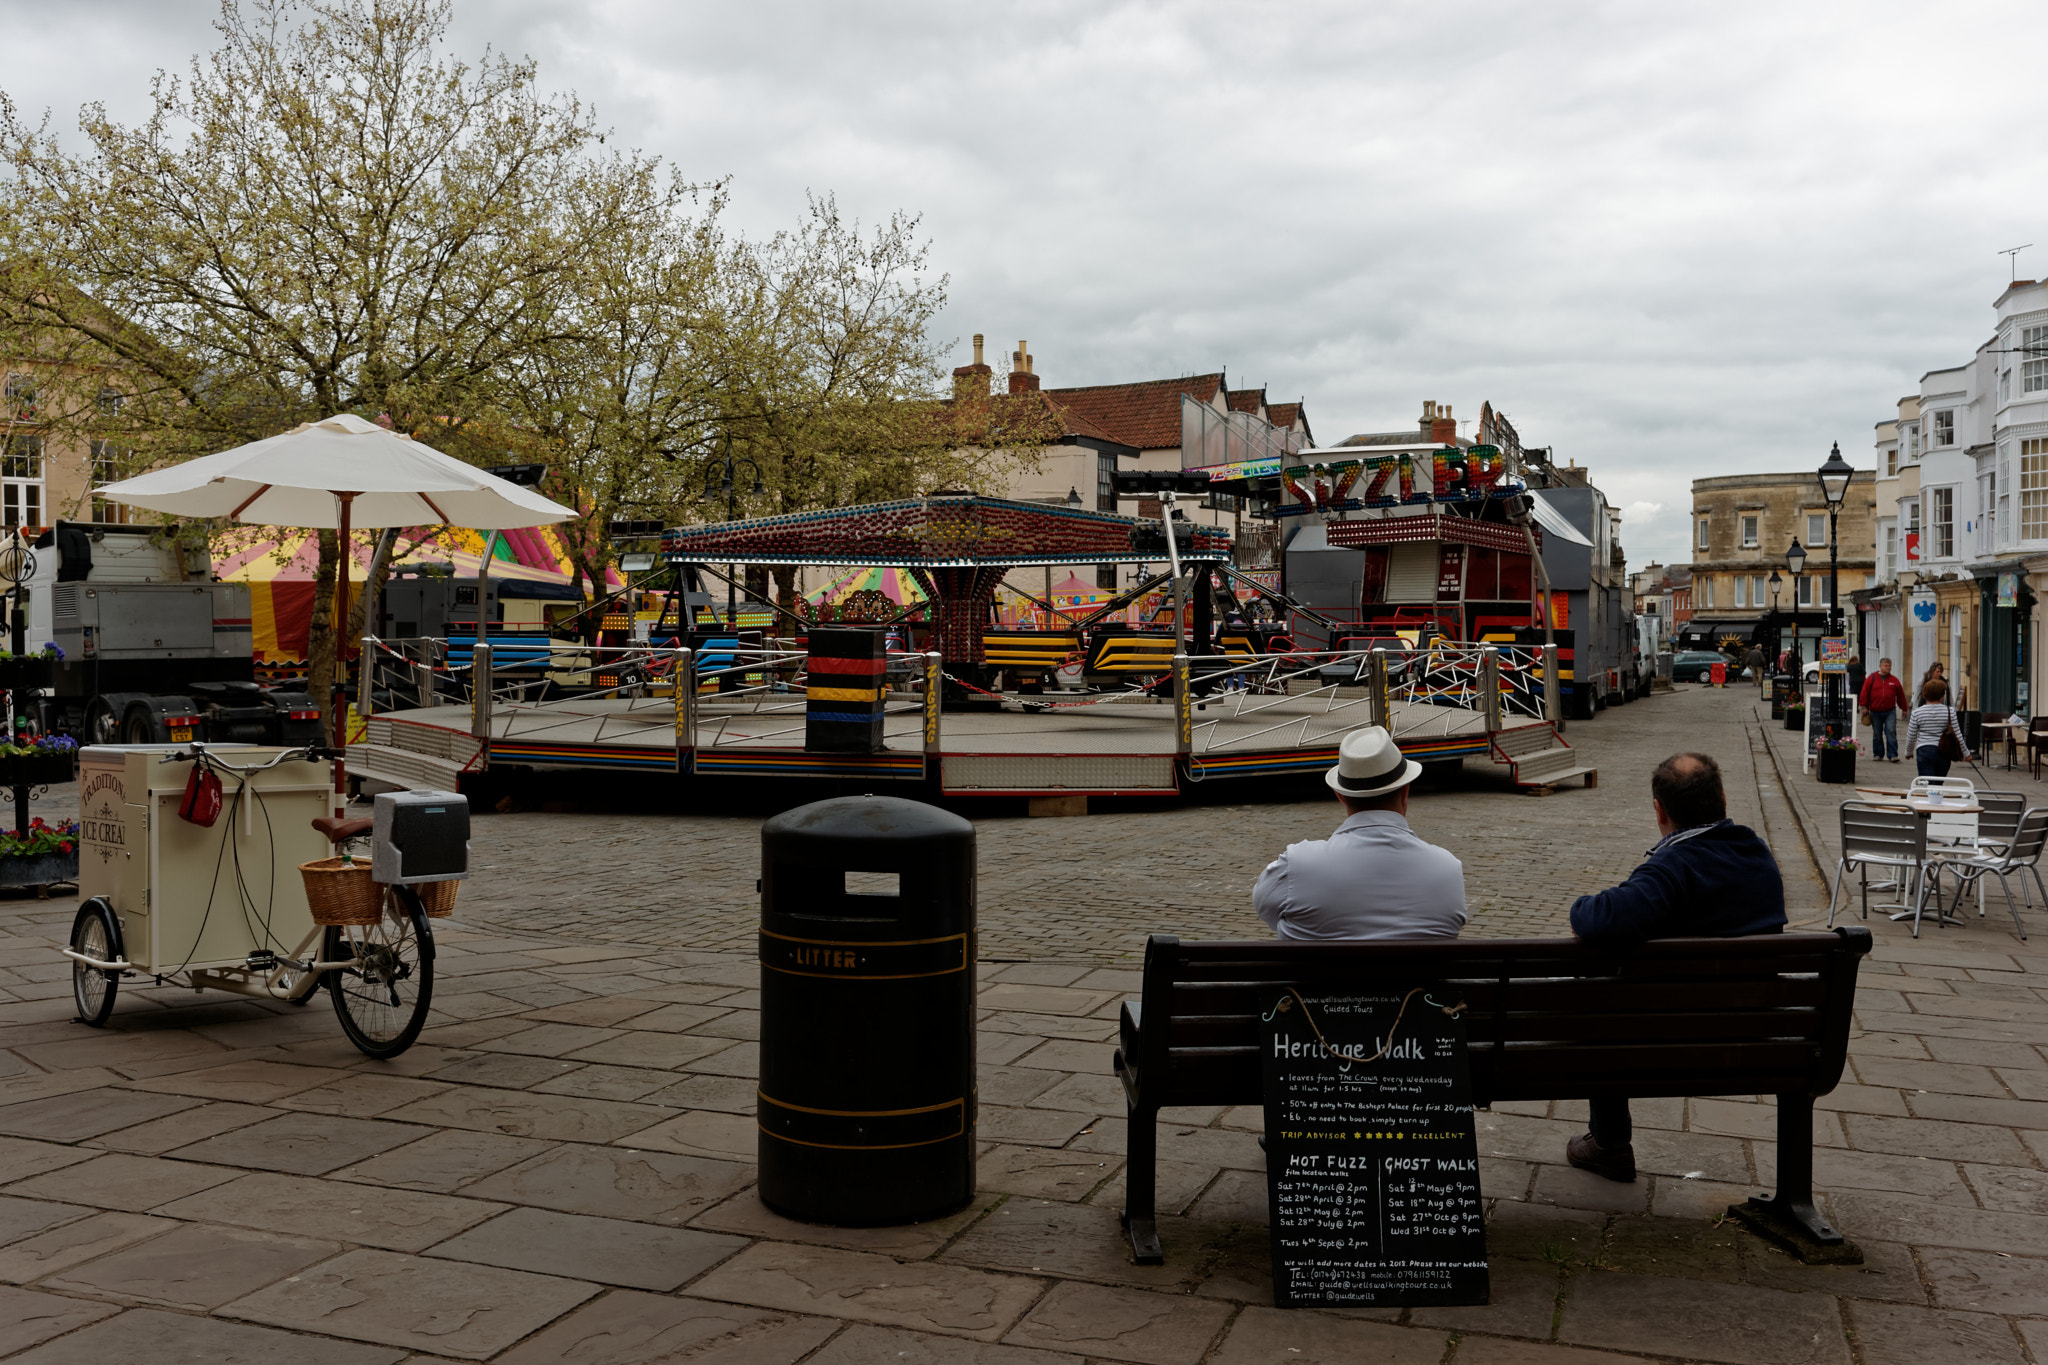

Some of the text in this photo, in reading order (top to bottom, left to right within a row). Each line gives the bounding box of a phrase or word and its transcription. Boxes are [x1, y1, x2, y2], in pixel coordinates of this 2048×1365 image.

[626, 675, 637, 685] 10
[675, 659, 684, 738] ZIGZAG
[926, 664, 938, 744] ZIGZAG
[1180, 665, 1191, 743] ZIGZAG
[82, 821, 97, 841] ICE
[797, 946, 857, 969] LITTER
[1323, 1004, 1374, 1015] Guided Tours
[1274, 1032, 1426, 1073] Heritage Walk
[1289, 1073, 1453, 1088] leaves from The Crown every Wednesday
[1289, 1100, 1308, 1108] 50%
[1387, 1102, 1410, 1110] Palace
[1443, 1104, 1455, 1112] 20
[1371, 1116, 1396, 1127] simply
[1419, 1117, 1431, 1127] up
[1280, 1131, 1467, 1141] TRIP ADVISOR EXCELLENT
[1289, 1153, 1368, 1170] HOT FUZZ
[1384, 1156, 1477, 1175] GHOST WALK
[1285, 1168, 1349, 1178] film location walks
[1277, 1181, 1294, 1191] Sat
[1388, 1183, 1406, 1193] Sat
[1278, 1194, 1294, 1203] Sat
[1388, 1197, 1405, 1208] Sat
[1427, 1199, 1444, 1211] Aug
[1278, 1206, 1295, 1215] Sat
[1280, 1218, 1296, 1227] Sat
[1389, 1213, 1407, 1222] Sat
[1433, 1213, 1450, 1222] Oct
[1390, 1226, 1411, 1236] Wed
[1431, 1226, 1448, 1236] Oct
[1280, 1239, 1300, 1248] Tues
[1297, 1258, 1315, 1267] will
[1316, 1259, 1333, 1267] add
[1334, 1260, 1353, 1268] more
[1354, 1260, 1377, 1268] dates
[1379, 1259, 1387, 1268] in
[1409, 1260, 1434, 1268] Please
[1463, 1260, 1489, 1269] website
